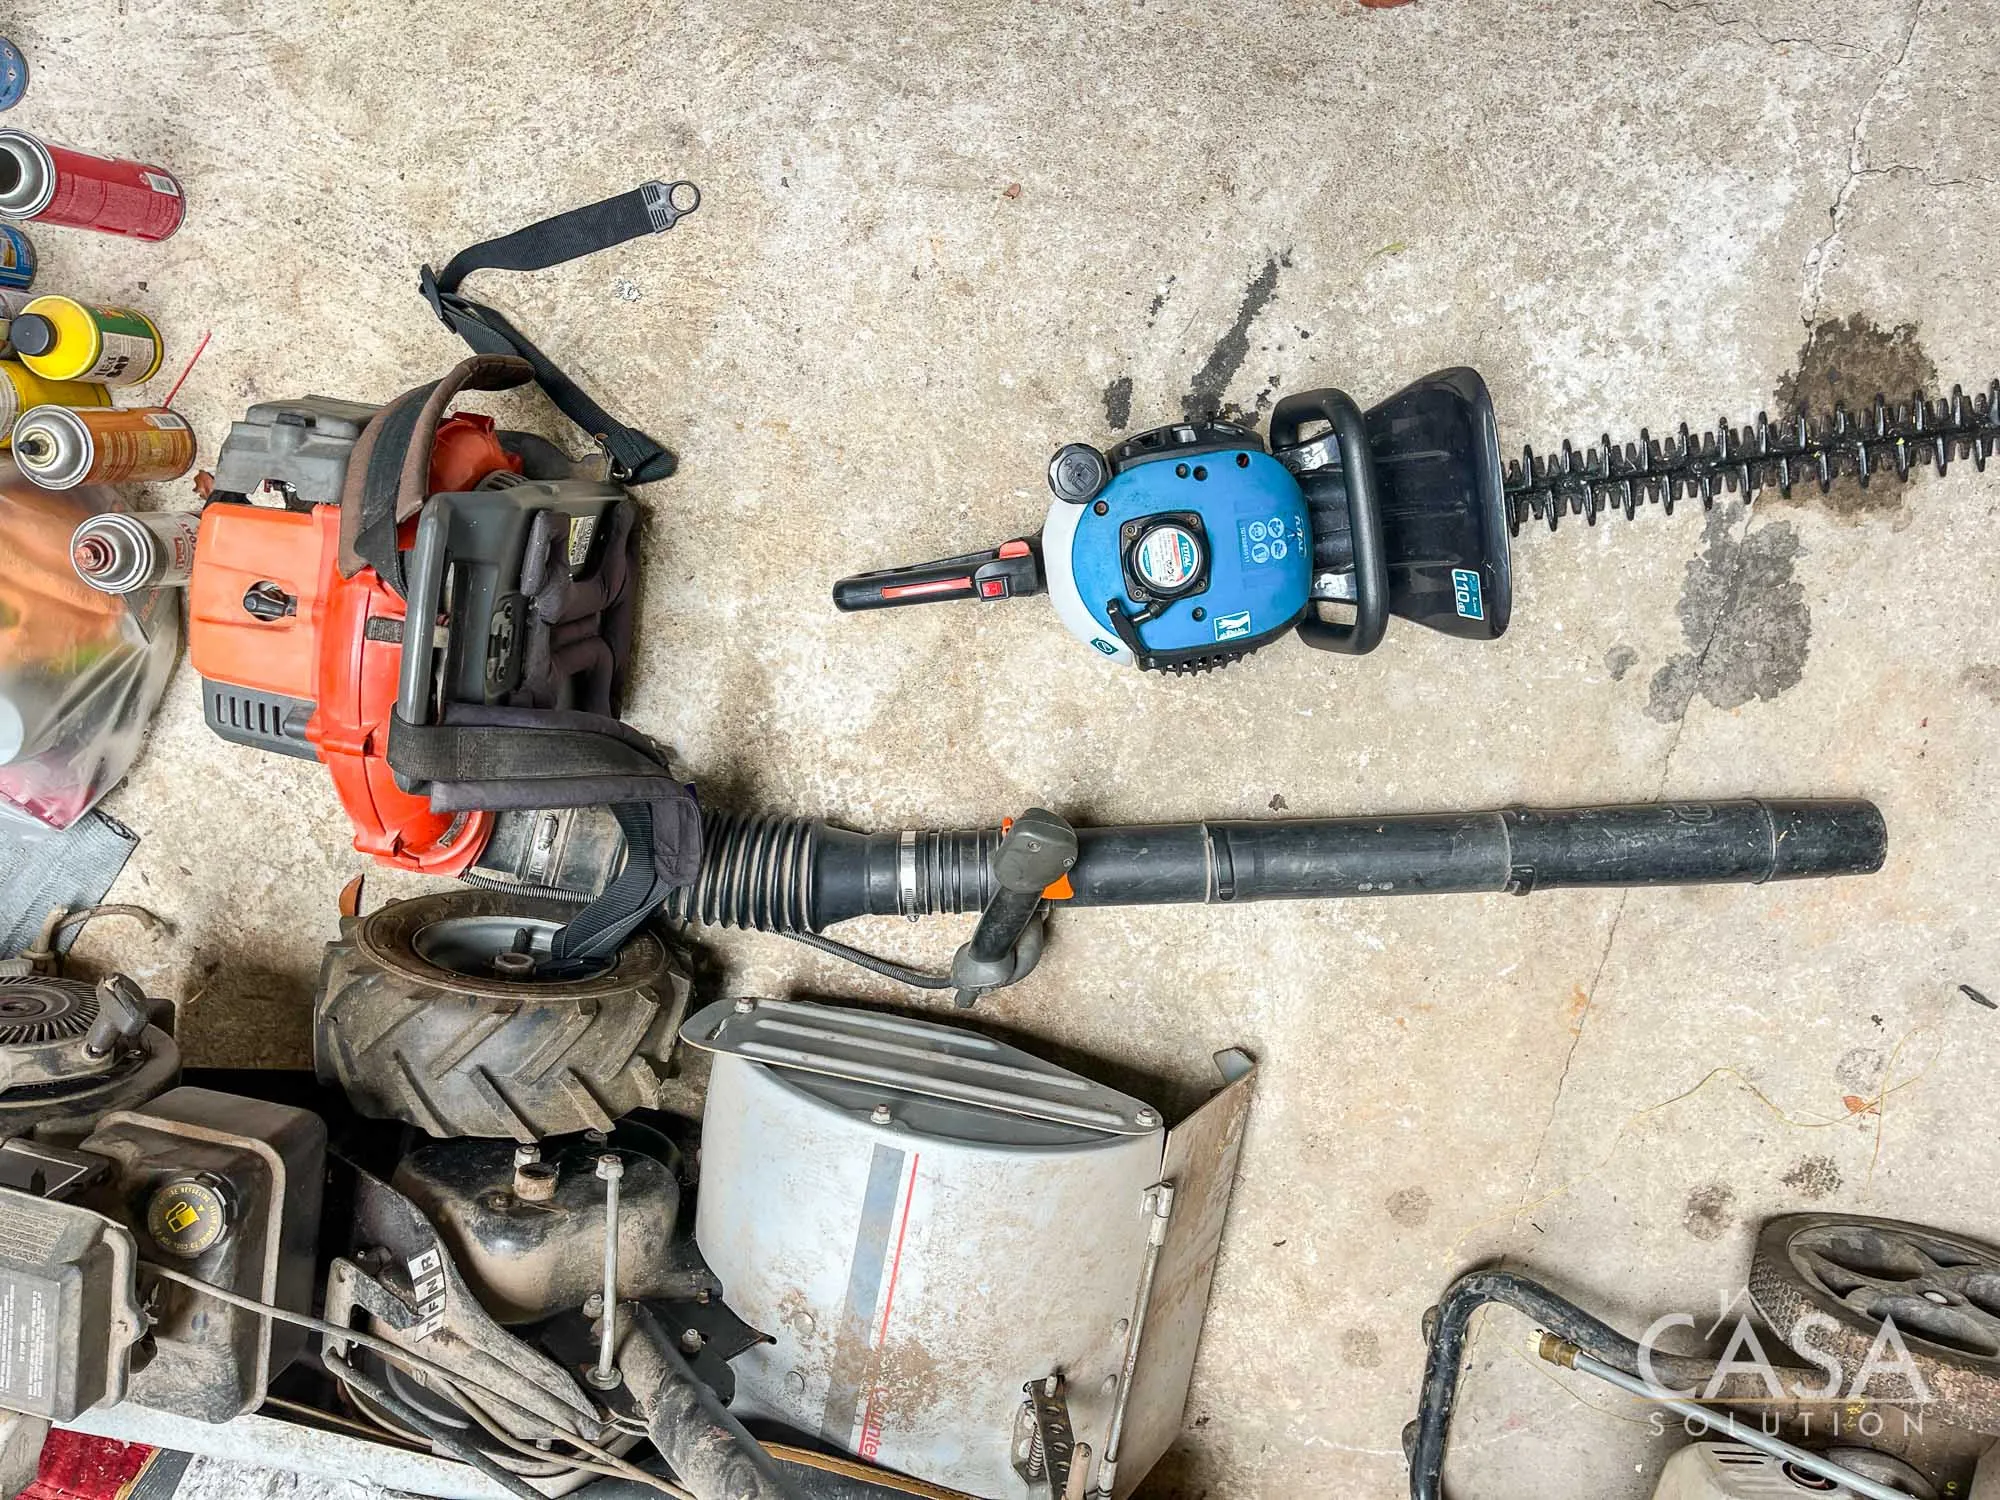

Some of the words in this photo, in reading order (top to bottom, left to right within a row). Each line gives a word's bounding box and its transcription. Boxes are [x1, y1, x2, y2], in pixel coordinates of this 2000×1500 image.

[1456, 573, 1470, 603] 110
[421, 1255, 433, 1272] R
[426, 1278, 438, 1294] N
[428, 1301, 439, 1313] F
